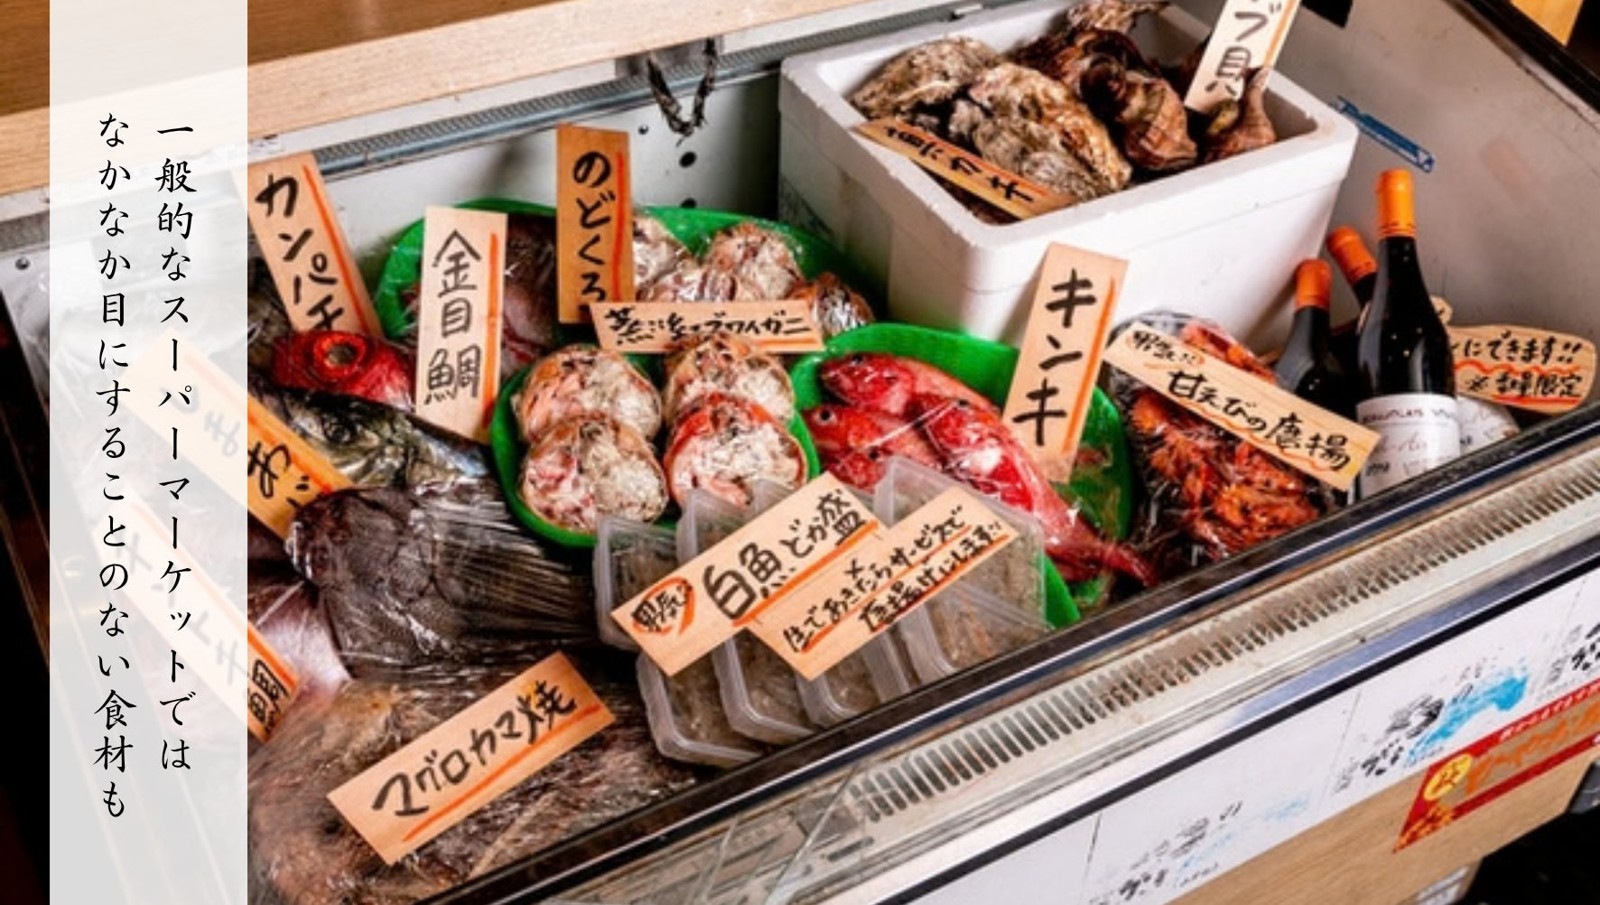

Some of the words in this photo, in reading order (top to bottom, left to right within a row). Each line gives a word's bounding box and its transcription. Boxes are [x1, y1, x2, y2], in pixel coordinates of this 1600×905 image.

[1205, 0, 1282, 97] ブ貝
[424, 229, 482, 405] 金目鯛
[1012, 268, 1098, 447] キンキ
[372, 680, 578, 817] マグロカマ焼
